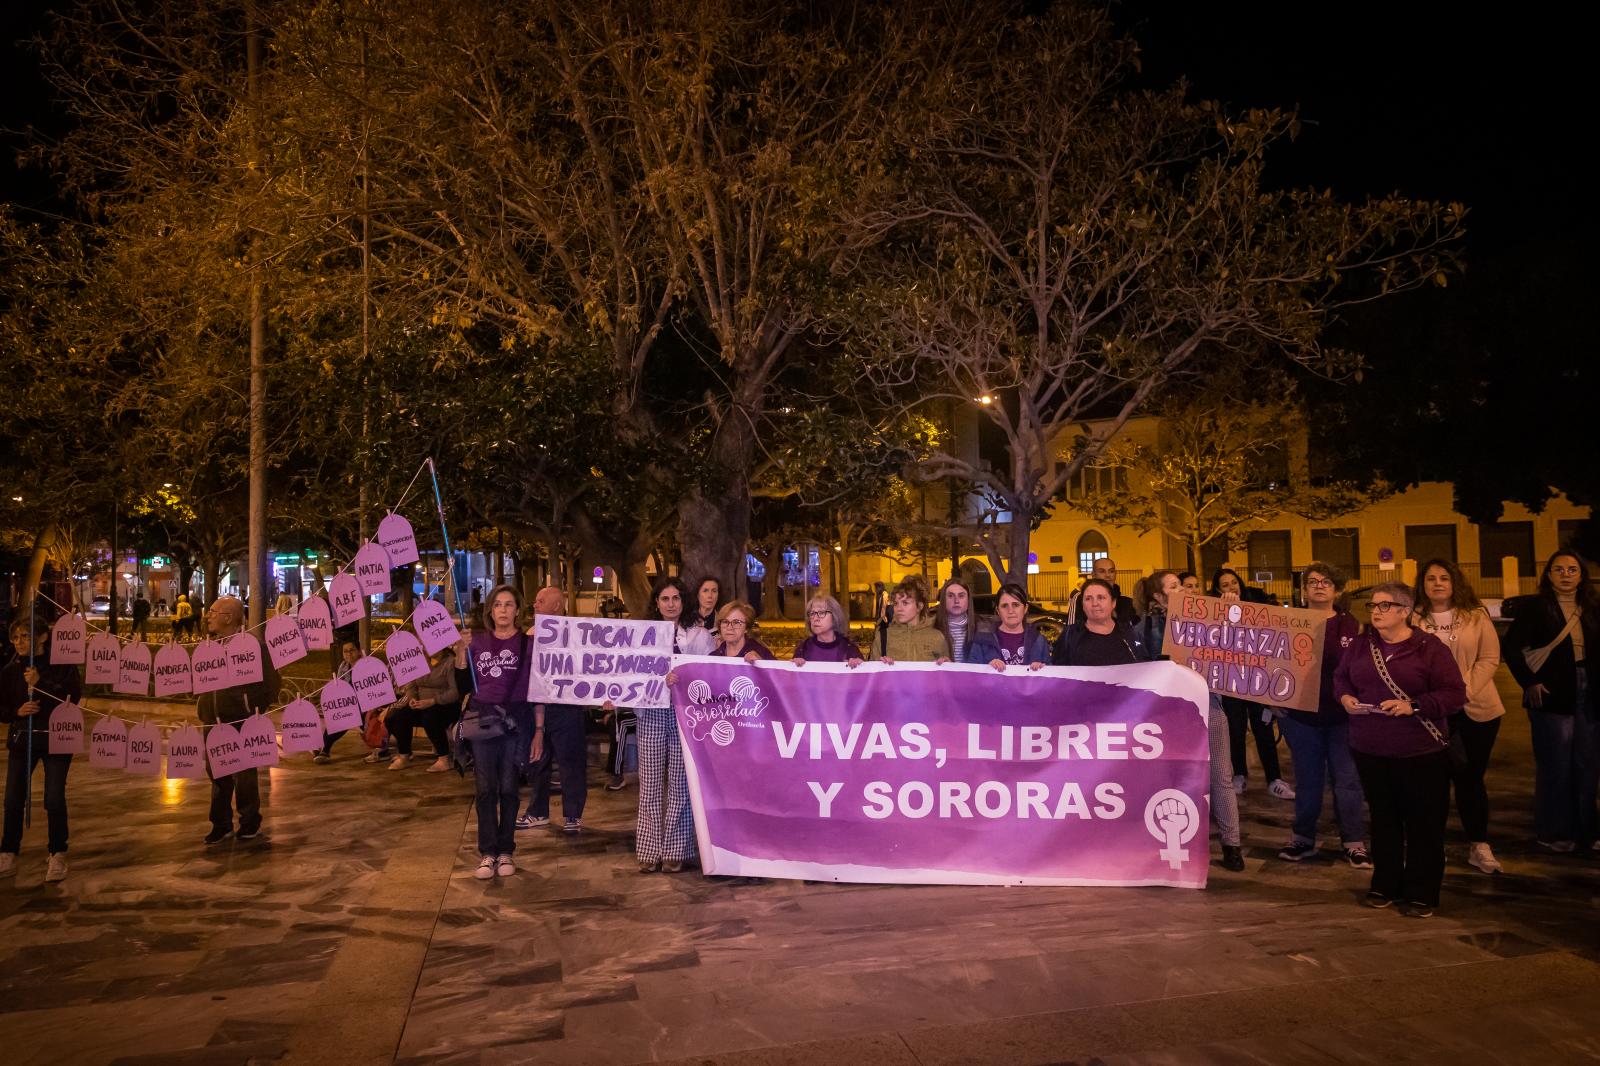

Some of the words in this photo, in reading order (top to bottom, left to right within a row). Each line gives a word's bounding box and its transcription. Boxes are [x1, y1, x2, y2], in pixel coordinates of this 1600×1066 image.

[359, 563, 384, 576] NATIA
[1182, 596, 1209, 620] ES
[1214, 602, 1271, 627] HORA
[1271, 615, 1288, 629] DE
[300, 618, 326, 630] BIANCA
[420, 615, 438, 631] ANA
[436, 613, 446, 621] Z
[269, 629, 300, 648] VANESA
[577, 622, 635, 648] TOCAN
[641, 626, 656, 646] A
[1171, 620, 1291, 660] VERGÜENZA
[195, 657, 226, 673] GRACIA
[539, 652, 573, 675] UNA
[1192, 647, 1246, 664] CAMBIE
[1249, 656, 1266, 667] DE
[156, 663, 189, 676] ANDREA
[354, 672, 388, 691] FLORICA
[322, 695, 358, 711] SOLEDAD
[685, 701, 764, 727] Sororidad
[52, 722, 82, 733] LORENA
[131, 741, 153, 753] ROSI
[210, 742, 240, 758] PETRA
[243, 734, 274, 749] AMAL
[771, 721, 947, 769] VIVAS,
[967, 722, 1164, 760] LIBRES
[171, 746, 198, 757] LAURA
[807, 781, 844, 818] Y
[862, 781, 1126, 819] SORORAS
